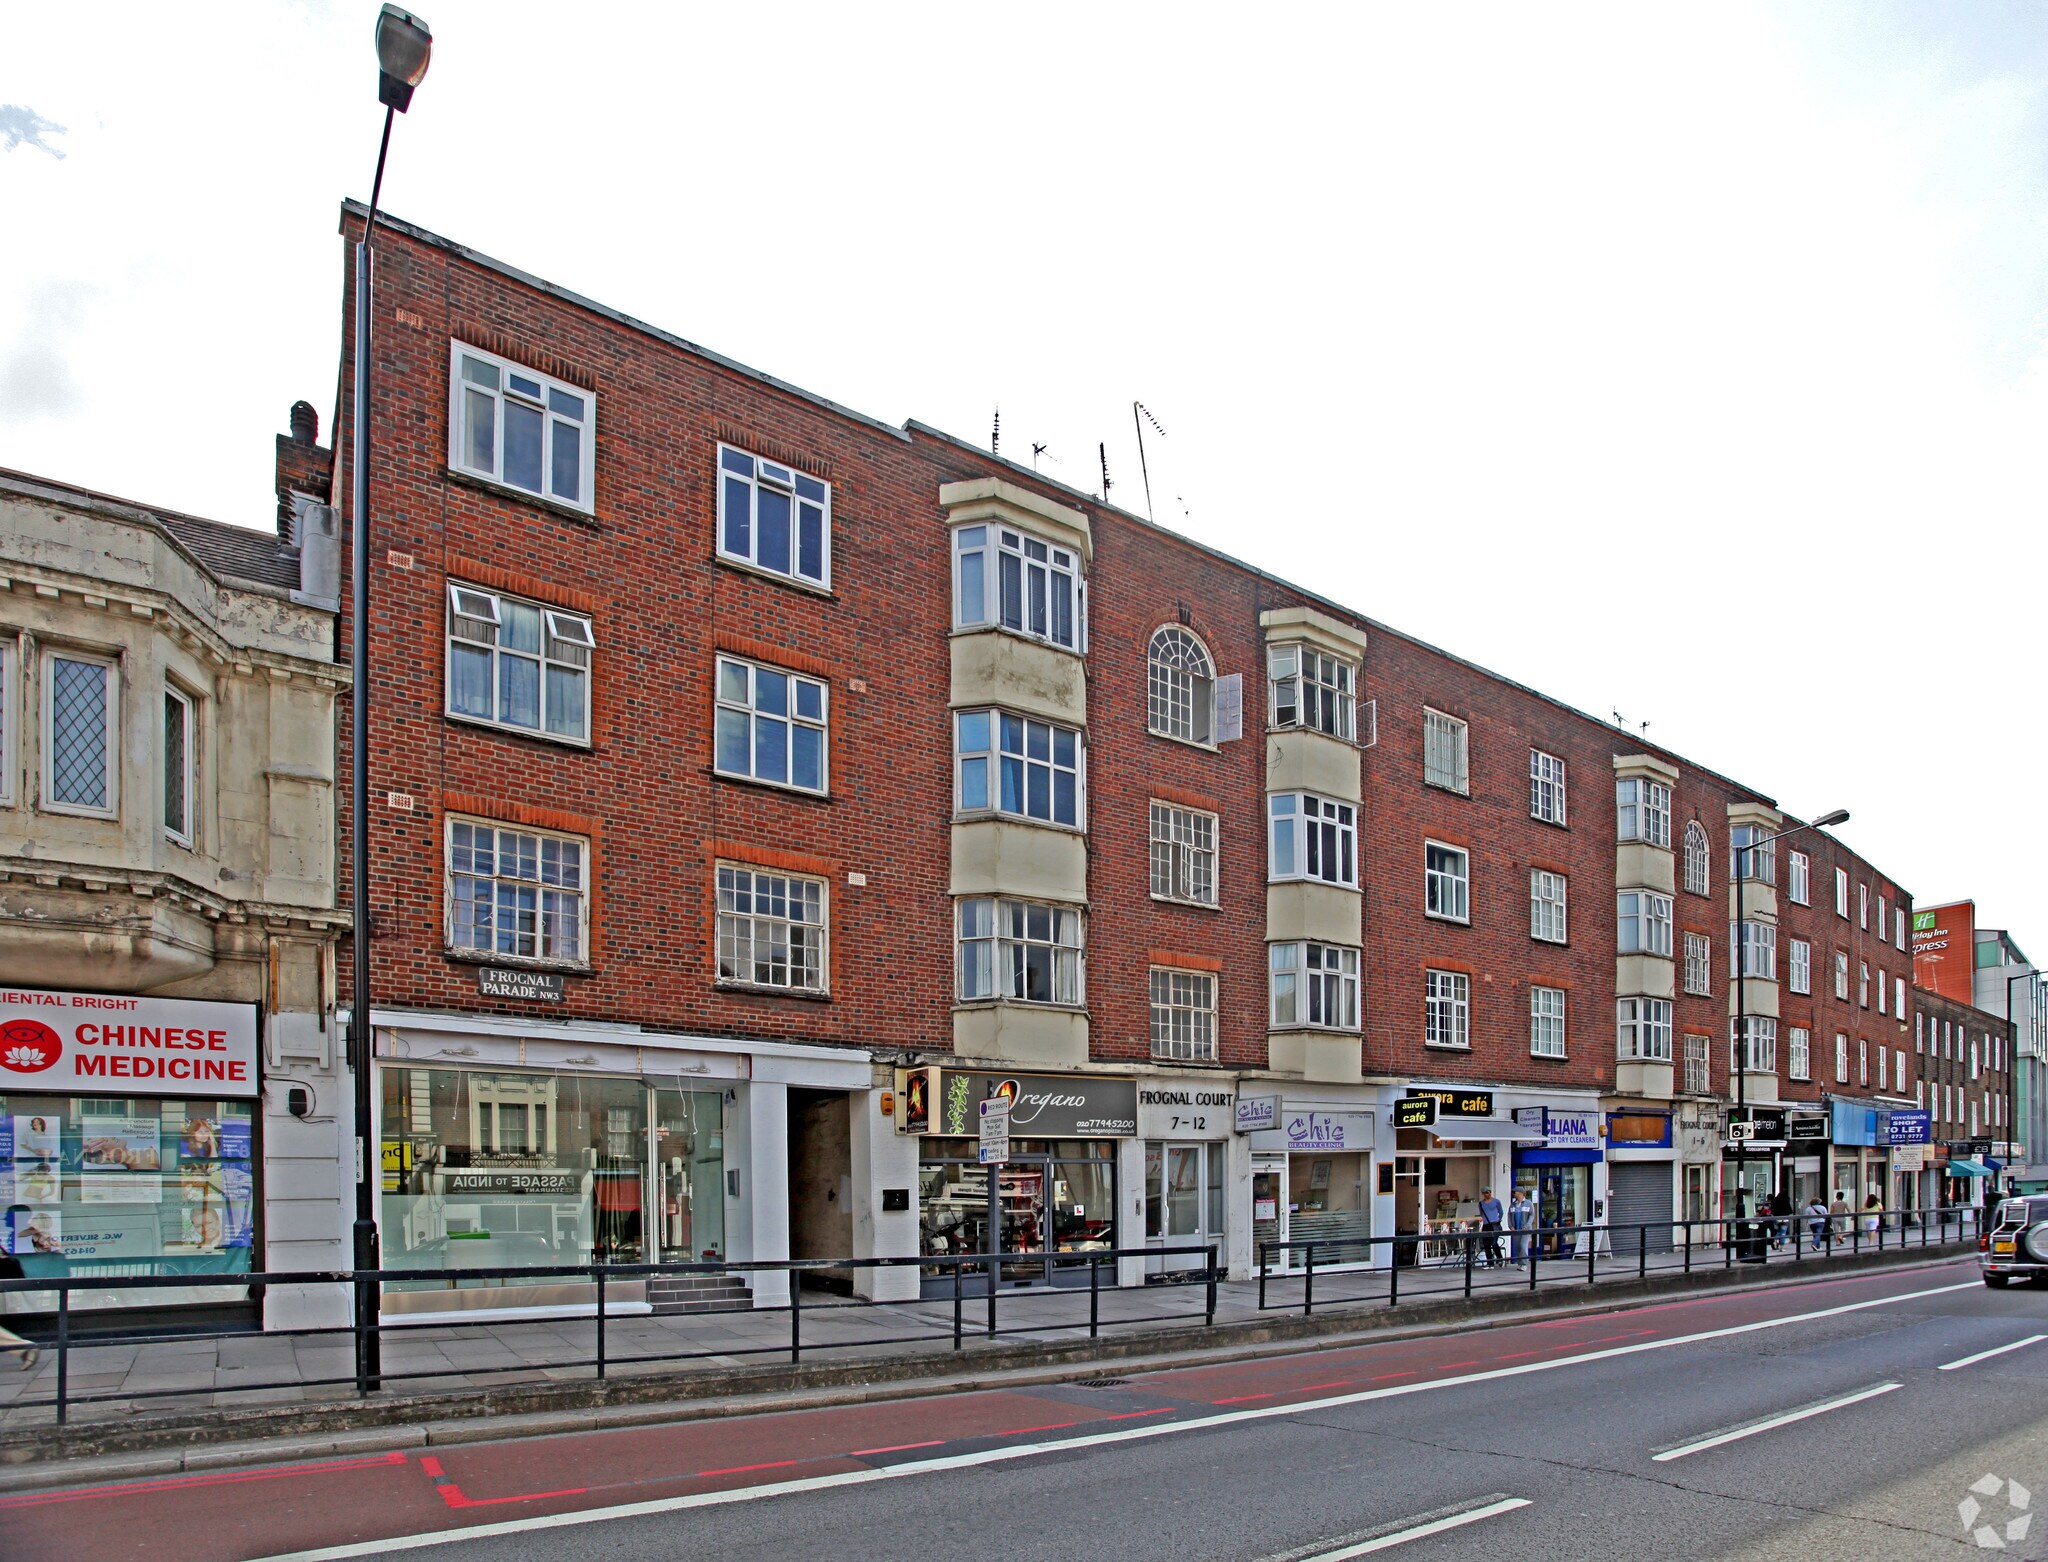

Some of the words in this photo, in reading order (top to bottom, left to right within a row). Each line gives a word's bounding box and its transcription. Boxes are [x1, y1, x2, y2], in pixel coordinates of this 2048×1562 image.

[489, 970, 554, 988] FROGNAL
[482, 982, 537, 998] PARADE
[72, 996, 138, 1011] BRIGHT
[75, 1023, 227, 1051] CHINESE
[75, 1054, 247, 1081] MEDICINE
[993, 1079, 1085, 1124] Oregano
[1140, 1091, 1193, 1105] FROGNAL
[1196, 1092, 1234, 1107] COURT
[1402, 1101, 1428, 1110] aurora
[1462, 1096, 1488, 1111] café
[1238, 1101, 1272, 1118] Chic
[1403, 1111, 1427, 1123] café
[1287, 1112, 1344, 1141] Chic
